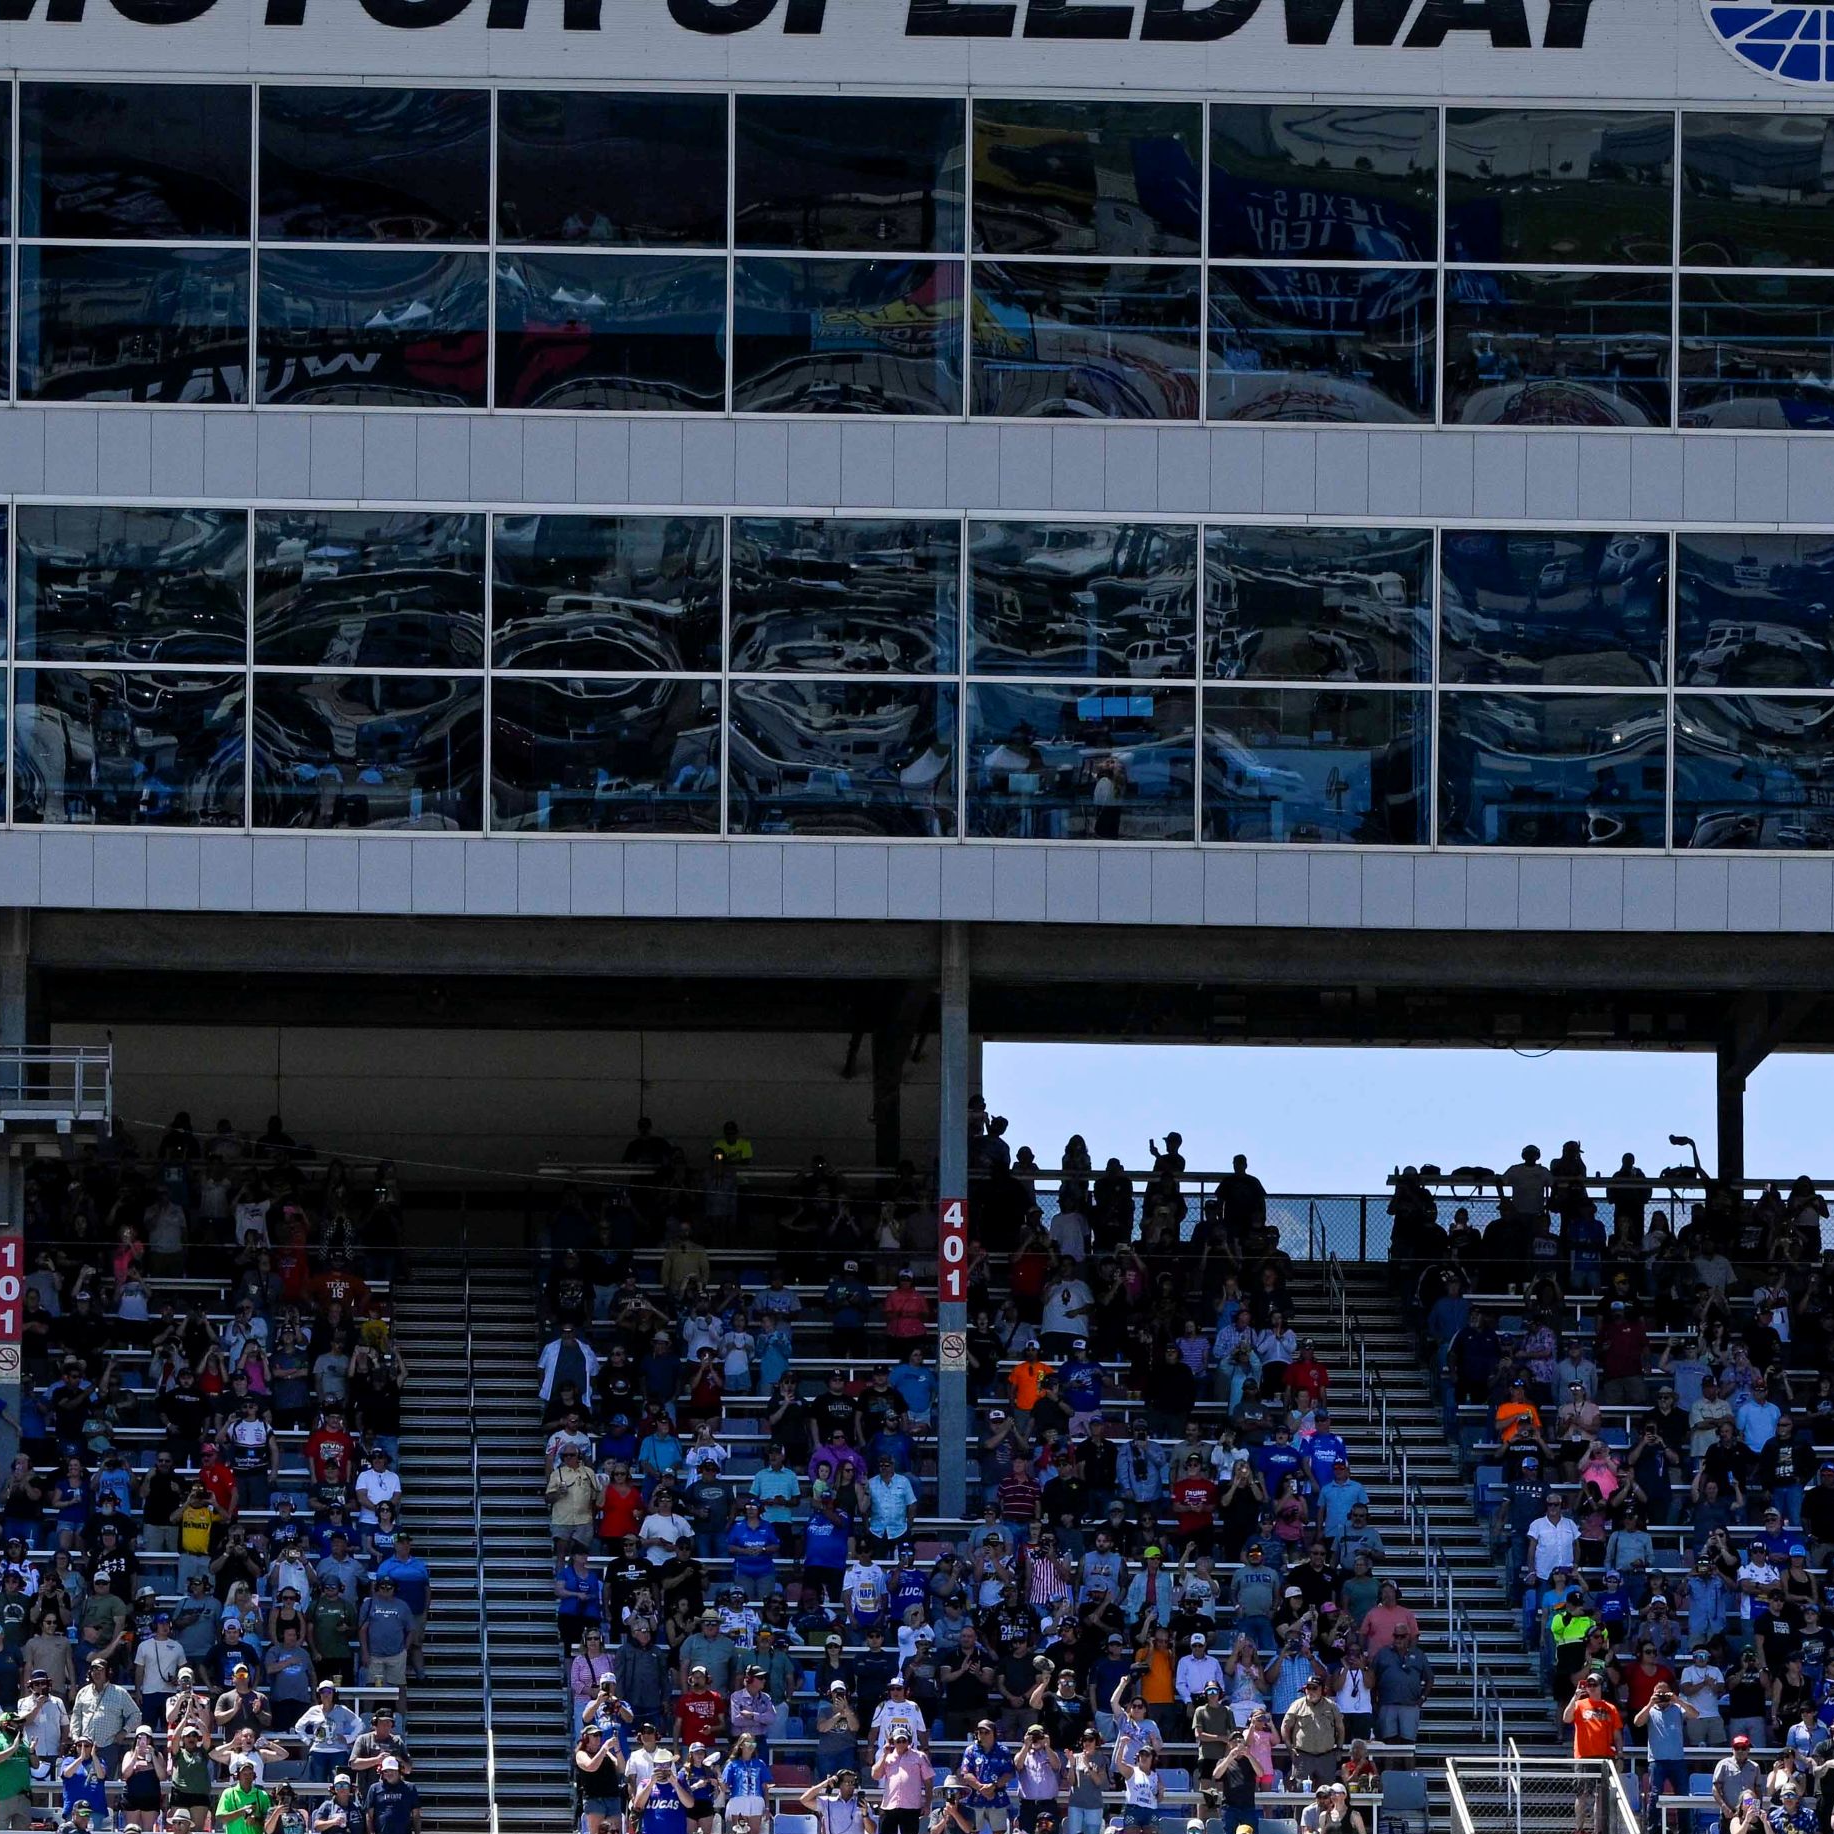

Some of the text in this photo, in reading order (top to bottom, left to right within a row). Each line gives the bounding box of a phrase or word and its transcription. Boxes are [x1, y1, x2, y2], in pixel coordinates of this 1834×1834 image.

[943, 1202, 964, 1295] 401
[326, 1282, 349, 1290] TEXAS
[332, 1289, 343, 1299] 16
[1781, 1310, 1786, 1323] 1
[1185, 1489, 1206, 1498] TRUMP
[859, 1586, 876, 1597] NAPA
[645, 1799, 678, 1811] LUCAS
